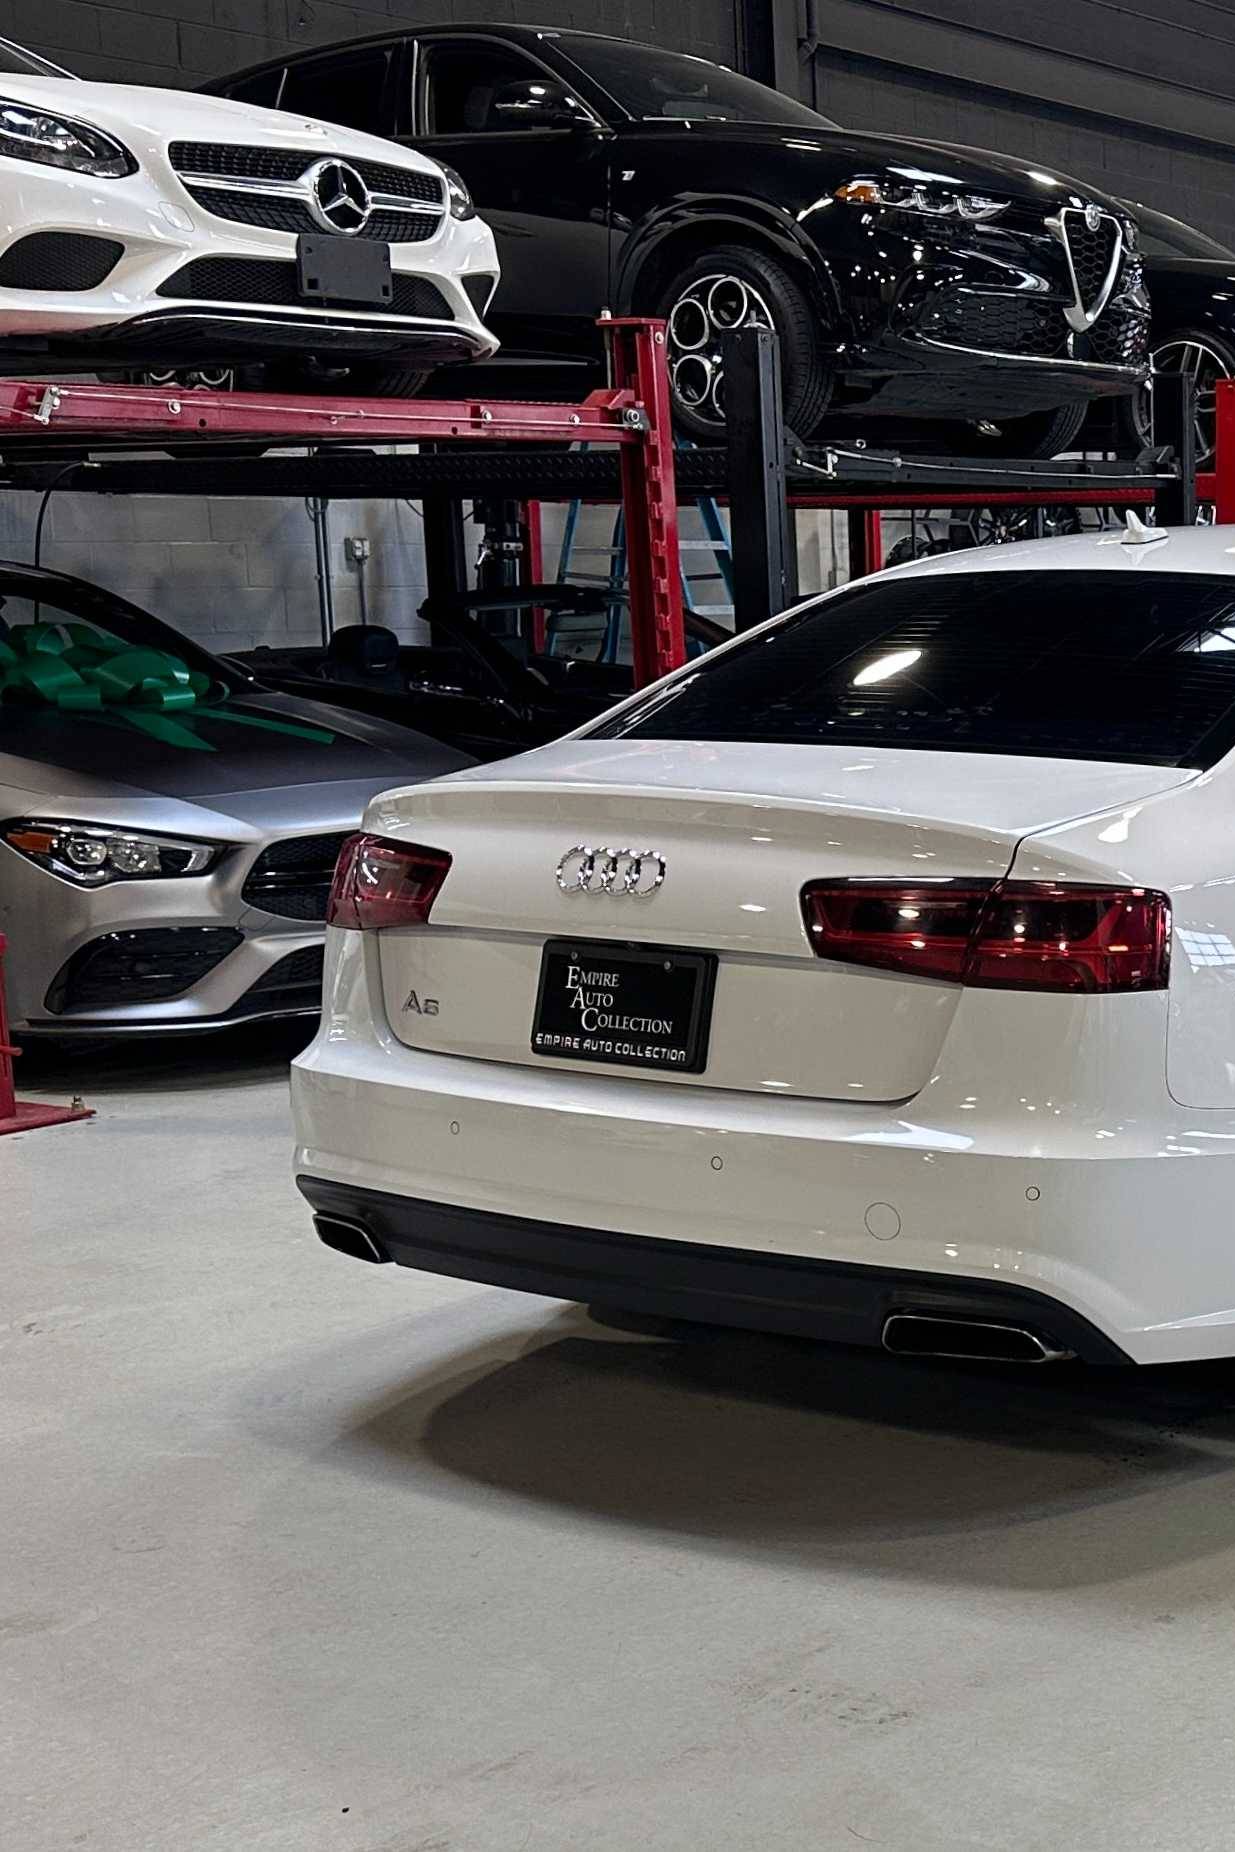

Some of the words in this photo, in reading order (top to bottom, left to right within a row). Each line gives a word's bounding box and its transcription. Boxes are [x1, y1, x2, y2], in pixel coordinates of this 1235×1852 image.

[401, 989, 439, 1016] A6
[535, 1033, 580, 1049] EMPIRE
[583, 1039, 613, 1054] AUTO
[615, 1043, 687, 1062] COLLECTION
